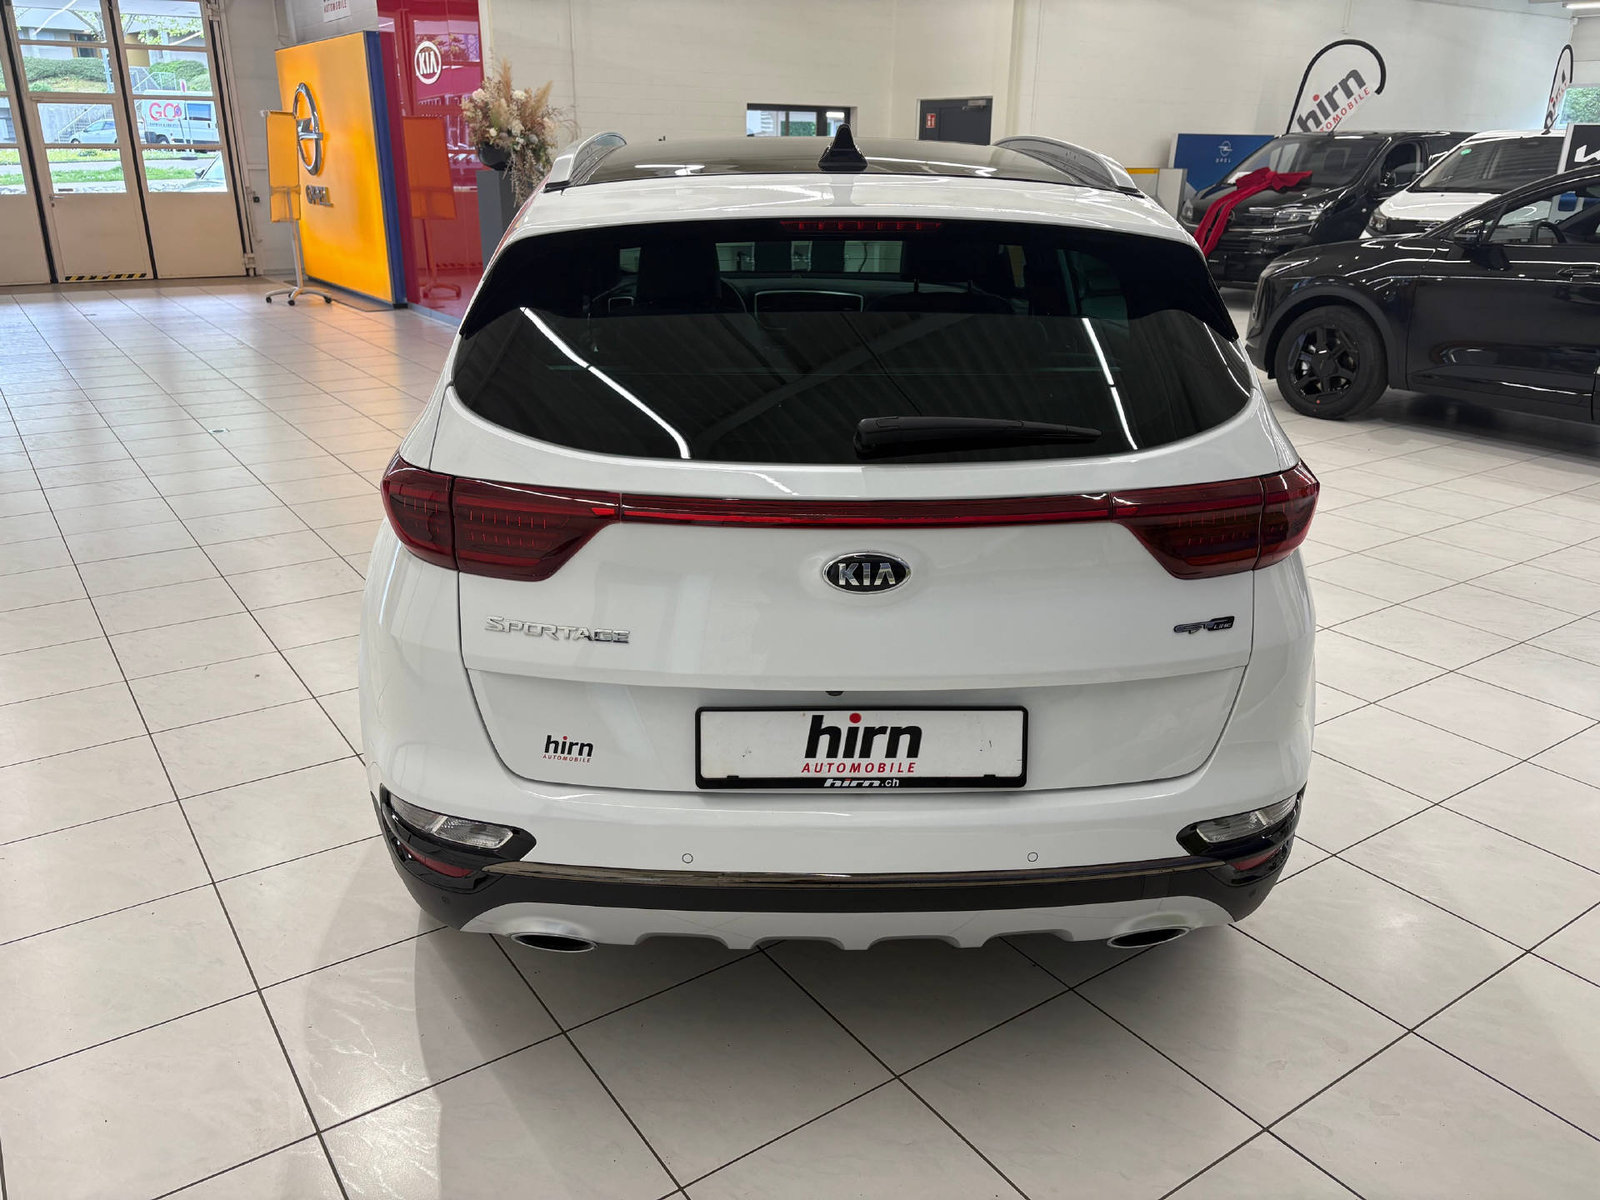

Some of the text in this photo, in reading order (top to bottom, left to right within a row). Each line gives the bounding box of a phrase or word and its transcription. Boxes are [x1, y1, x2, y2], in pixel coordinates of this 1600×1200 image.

[419, 51, 438, 75] KIA
[1296, 69, 1366, 132] hirn
[305, 185, 334, 208] OPEL
[838, 562, 896, 586] KIA
[485, 615, 631, 644] SPORTAGE
[544, 735, 594, 757] hirn
[804, 712, 923, 759] hirn
[542, 754, 591, 763] AUTOMOBILE
[801, 762, 916, 773] AUTOMOBILE
[823, 778, 900, 787] hirn.ch
